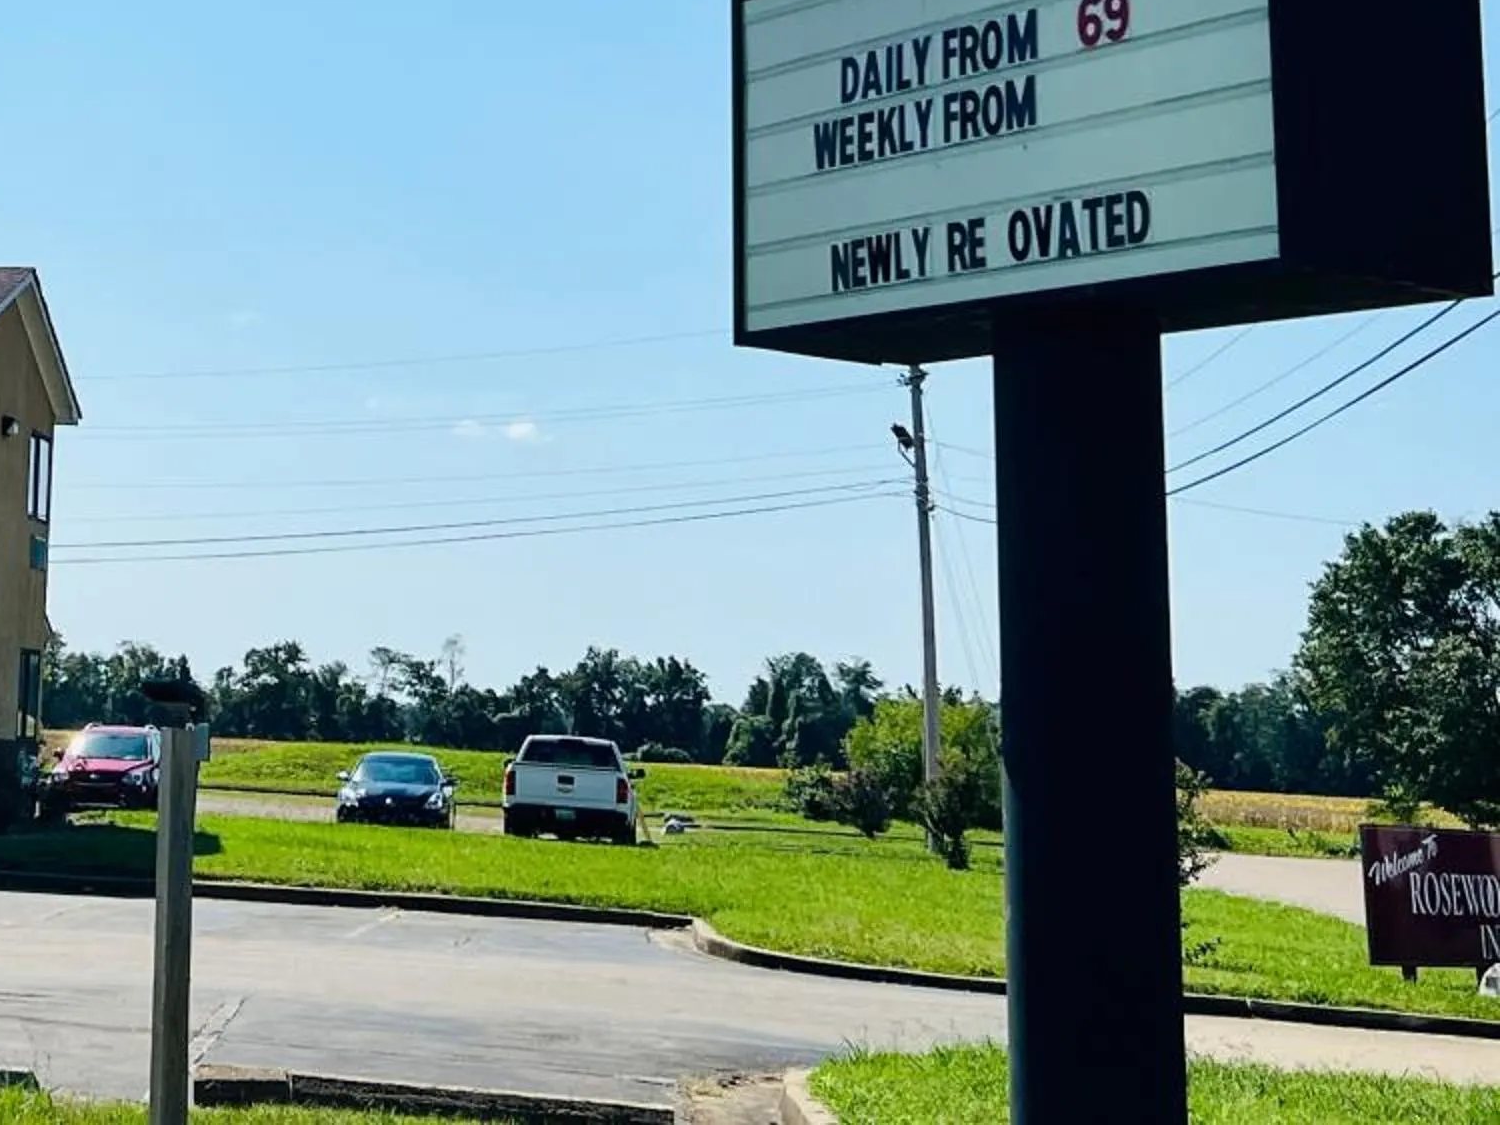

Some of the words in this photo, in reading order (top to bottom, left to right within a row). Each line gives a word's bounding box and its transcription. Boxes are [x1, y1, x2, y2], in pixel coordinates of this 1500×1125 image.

[840, 35, 929, 103] DAILY
[942, 9, 1039, 79] FROM
[814, 99, 933, 170] WEEKLY
[943, 75, 1038, 143] FROM
[830, 227, 929, 292] NEWLY
[947, 218, 986, 272] RE
[1008, 190, 1150, 261] OVATED
[1368, 848, 1424, 886] Welcome
[1409, 872, 1500, 917] ROSEWOO
[1480, 924, 1500, 960] IN
